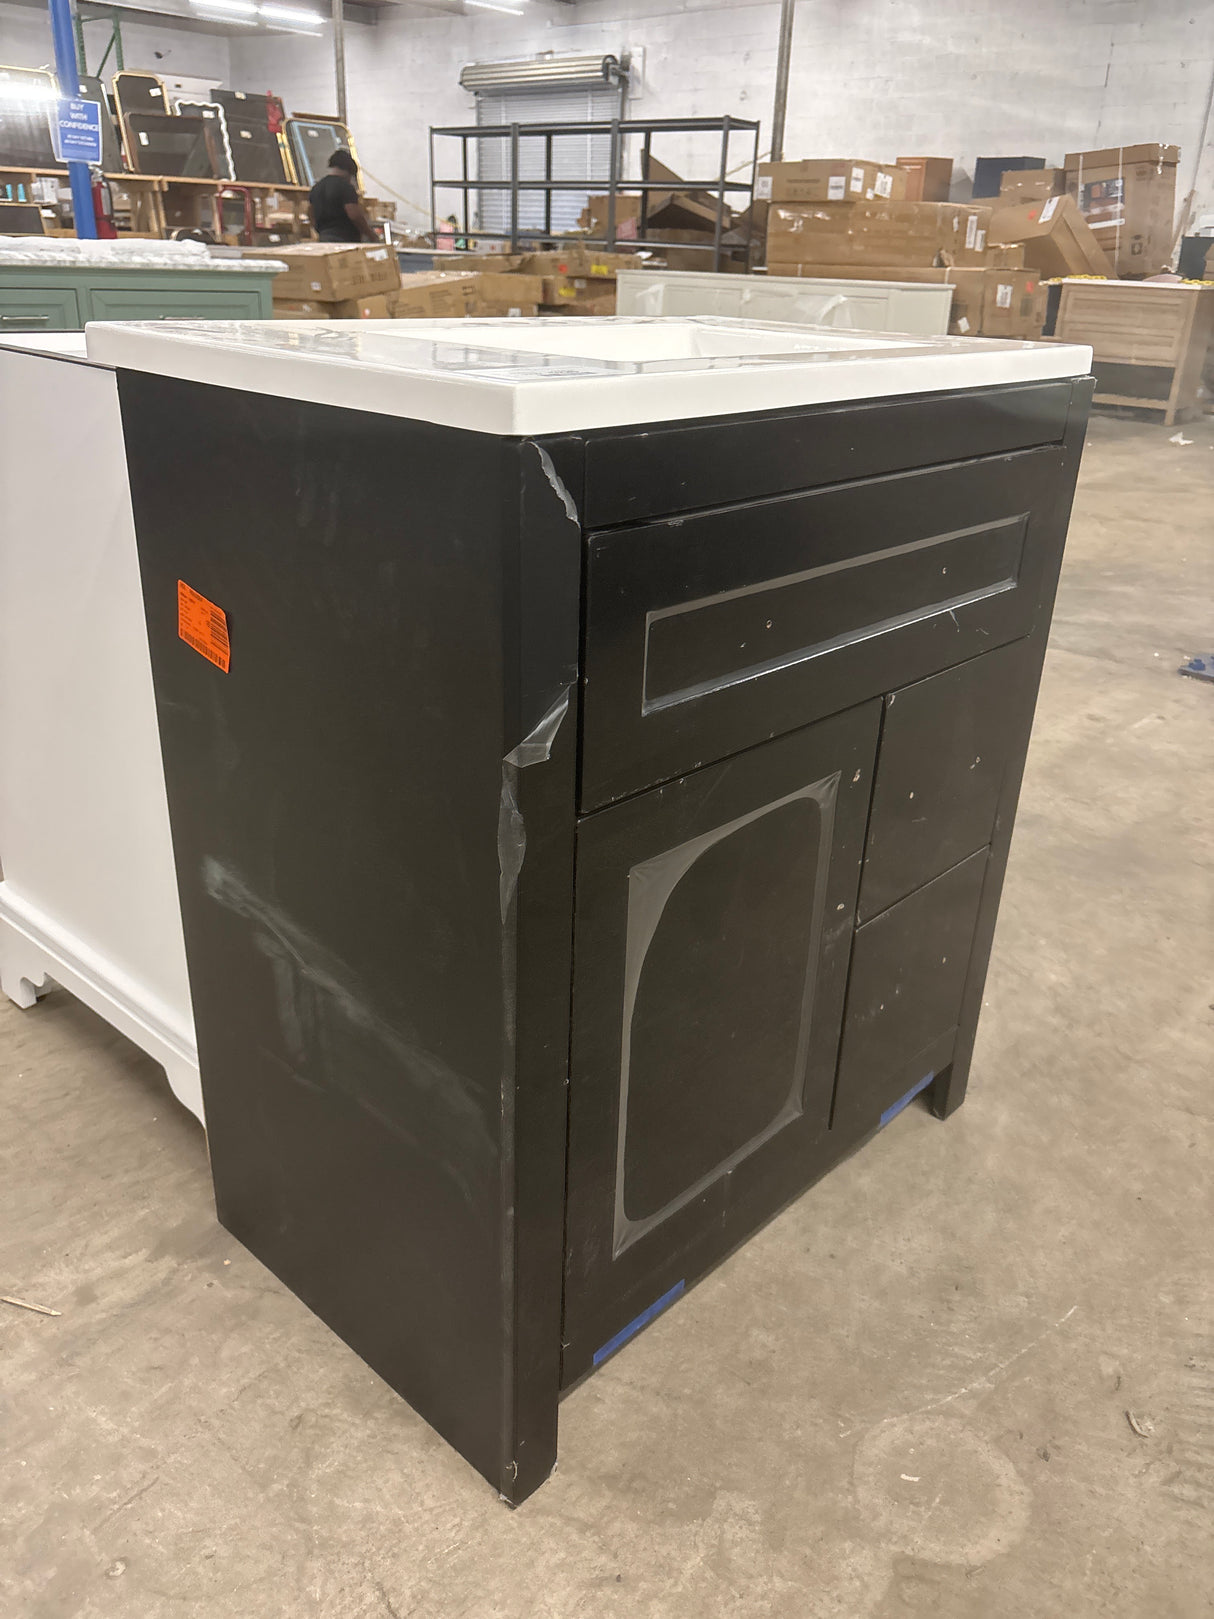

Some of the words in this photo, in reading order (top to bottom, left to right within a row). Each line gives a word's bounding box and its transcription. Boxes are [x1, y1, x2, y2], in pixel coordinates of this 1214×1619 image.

[69, 102, 84, 111] BUY
[69, 112, 88, 121] WITH
[59, 119, 99, 132] CONFIDENCE
